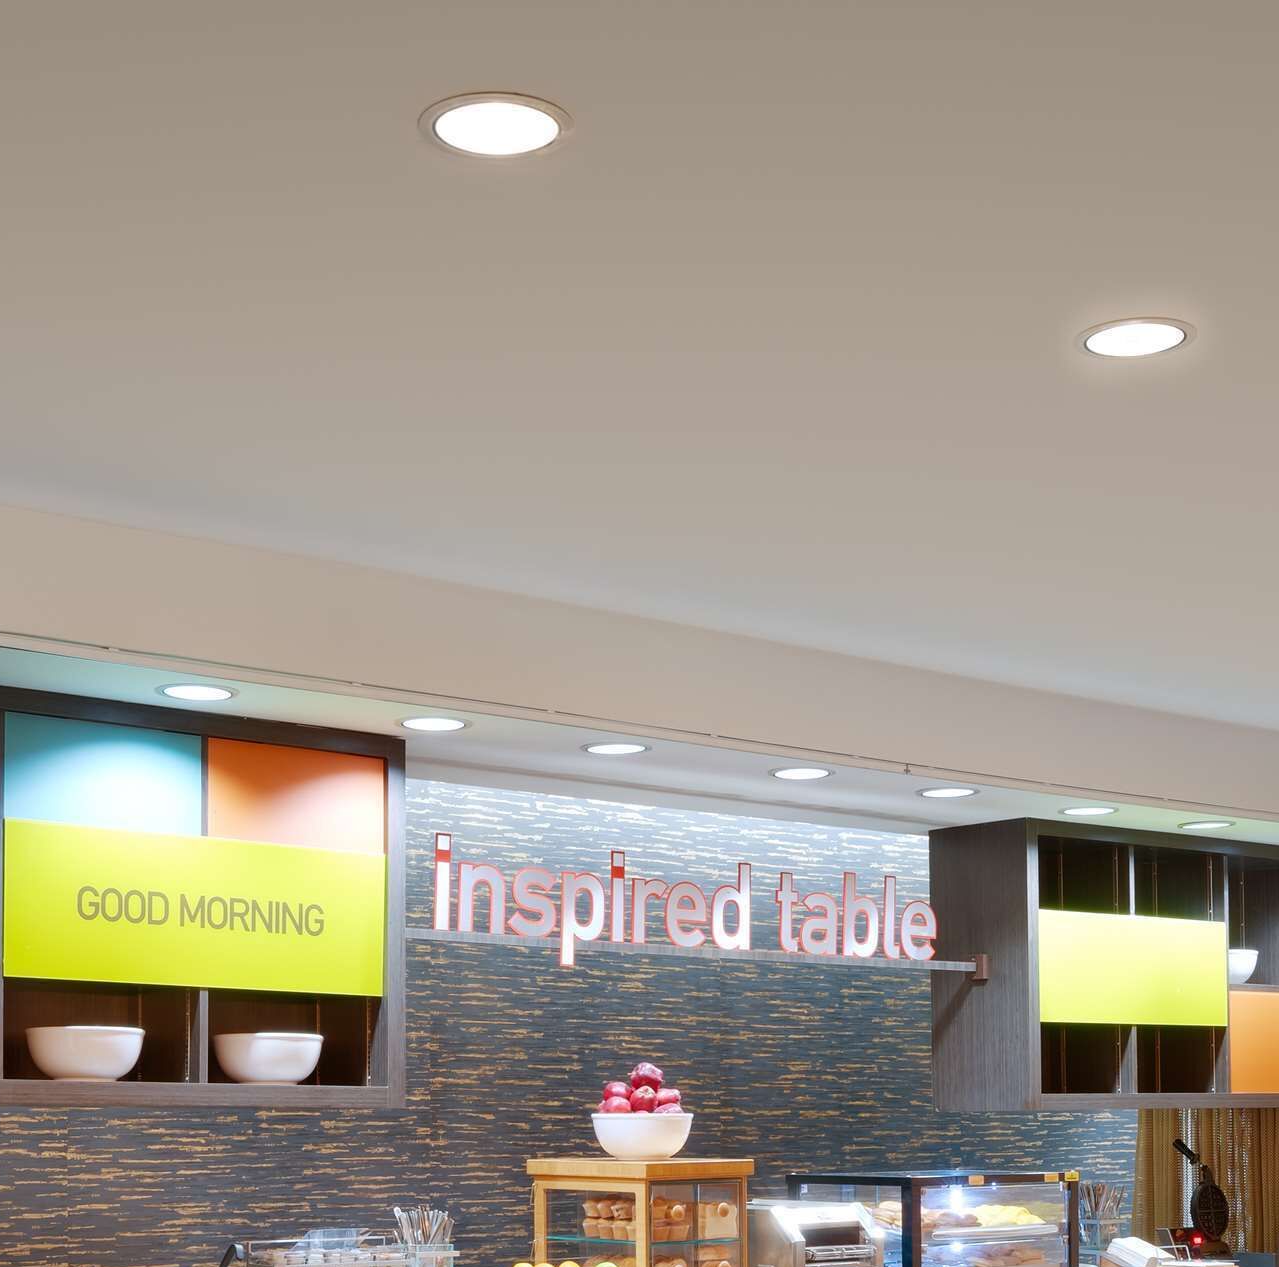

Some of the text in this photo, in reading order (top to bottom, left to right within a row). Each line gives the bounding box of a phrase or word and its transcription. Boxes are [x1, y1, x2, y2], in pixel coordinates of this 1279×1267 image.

[76, 884, 325, 938] GOOD MORNING
[433, 831, 938, 967] inspired table
